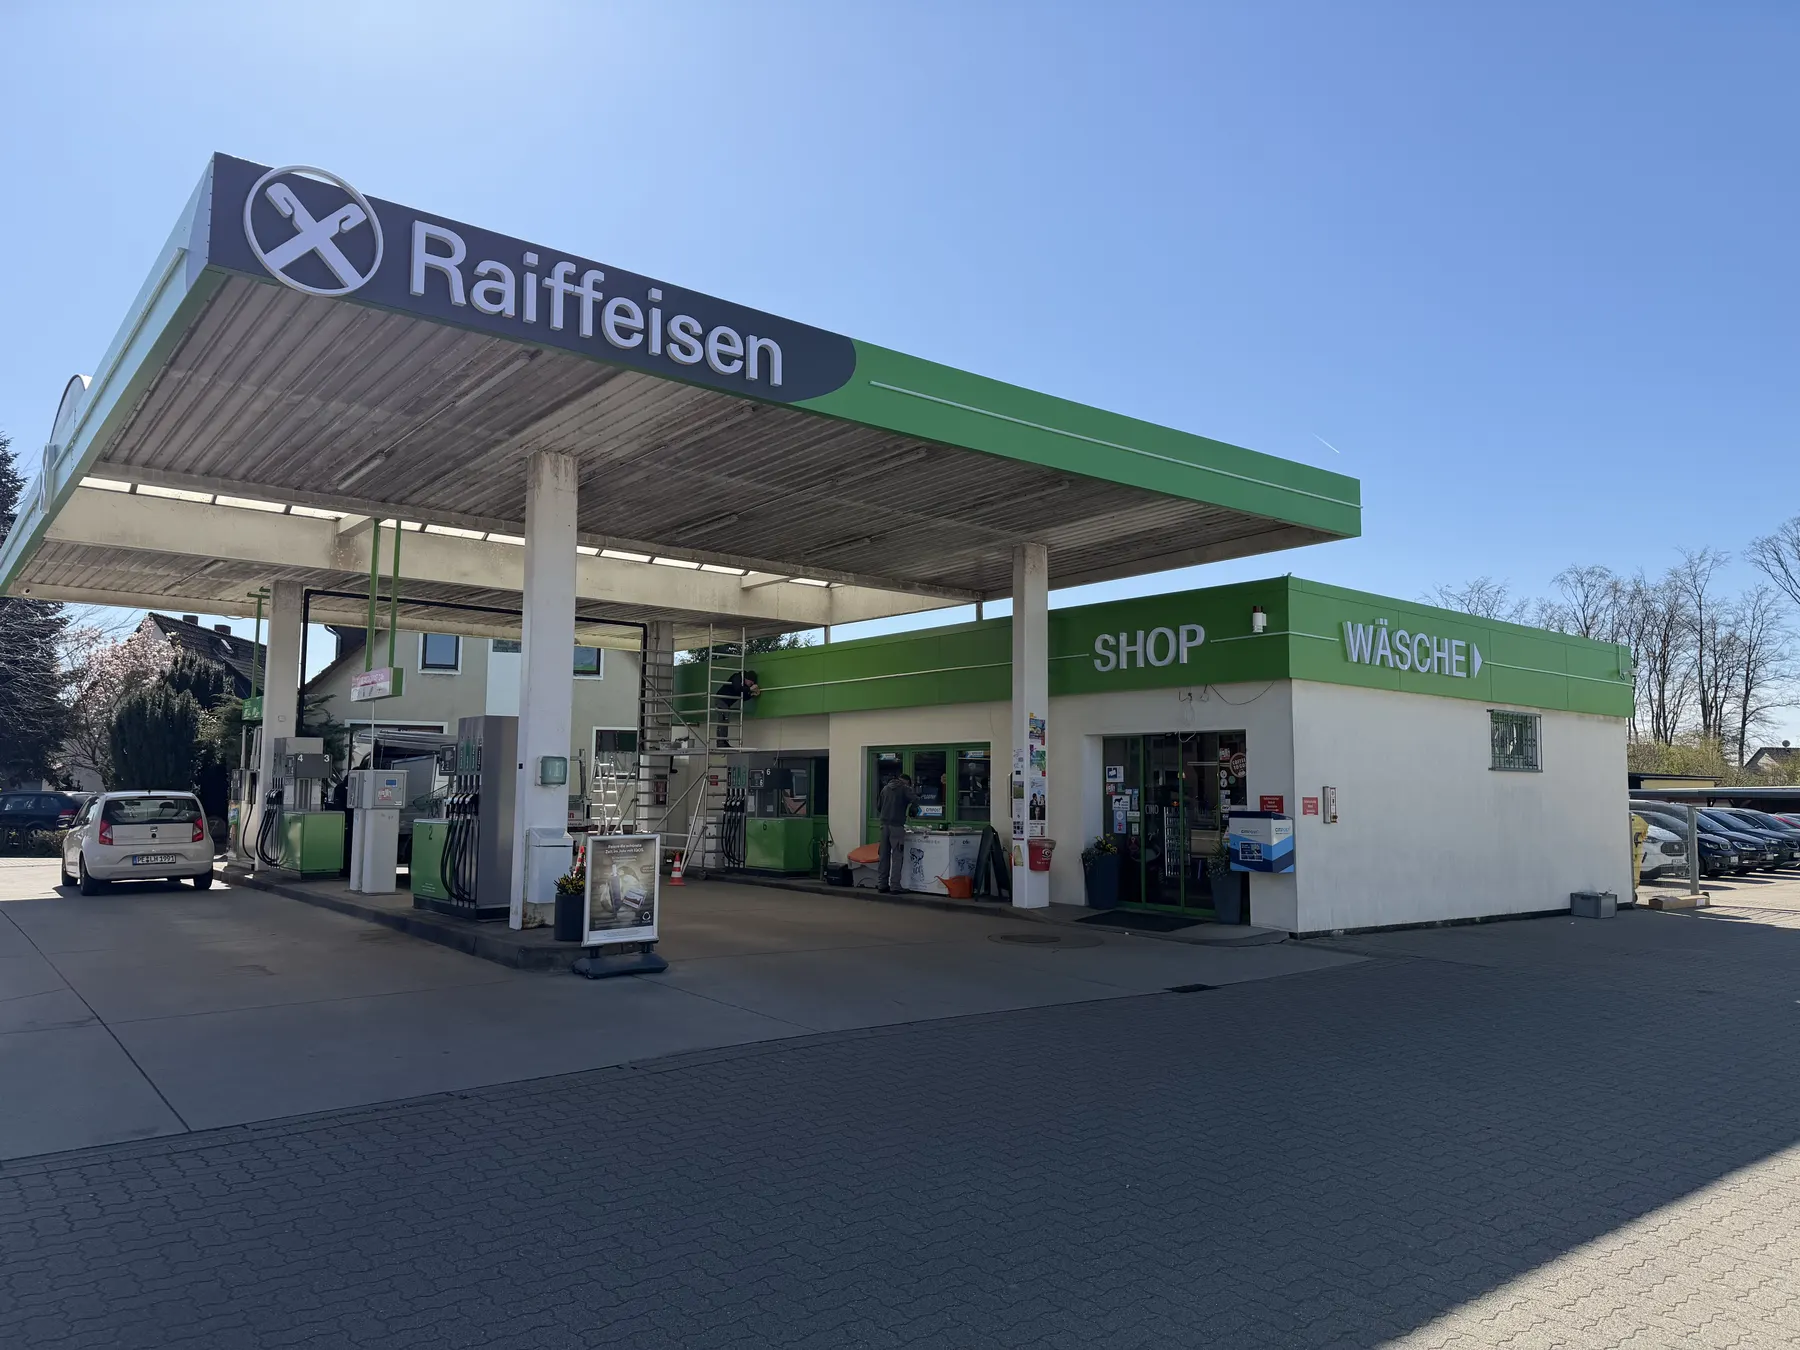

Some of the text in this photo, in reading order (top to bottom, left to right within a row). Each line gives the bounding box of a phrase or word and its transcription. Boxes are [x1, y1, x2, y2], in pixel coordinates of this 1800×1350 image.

[410, 219, 783, 387] Raiffeisen
[1094, 624, 1206, 672] SHOP
[1342, 618, 1467, 678] WÄSCHE
[297, 754, 304, 762] 4
[323, 754, 330, 763] 3
[766, 768, 771, 776] 6
[428, 825, 433, 840] 2
[137, 855, 145, 864] PE
